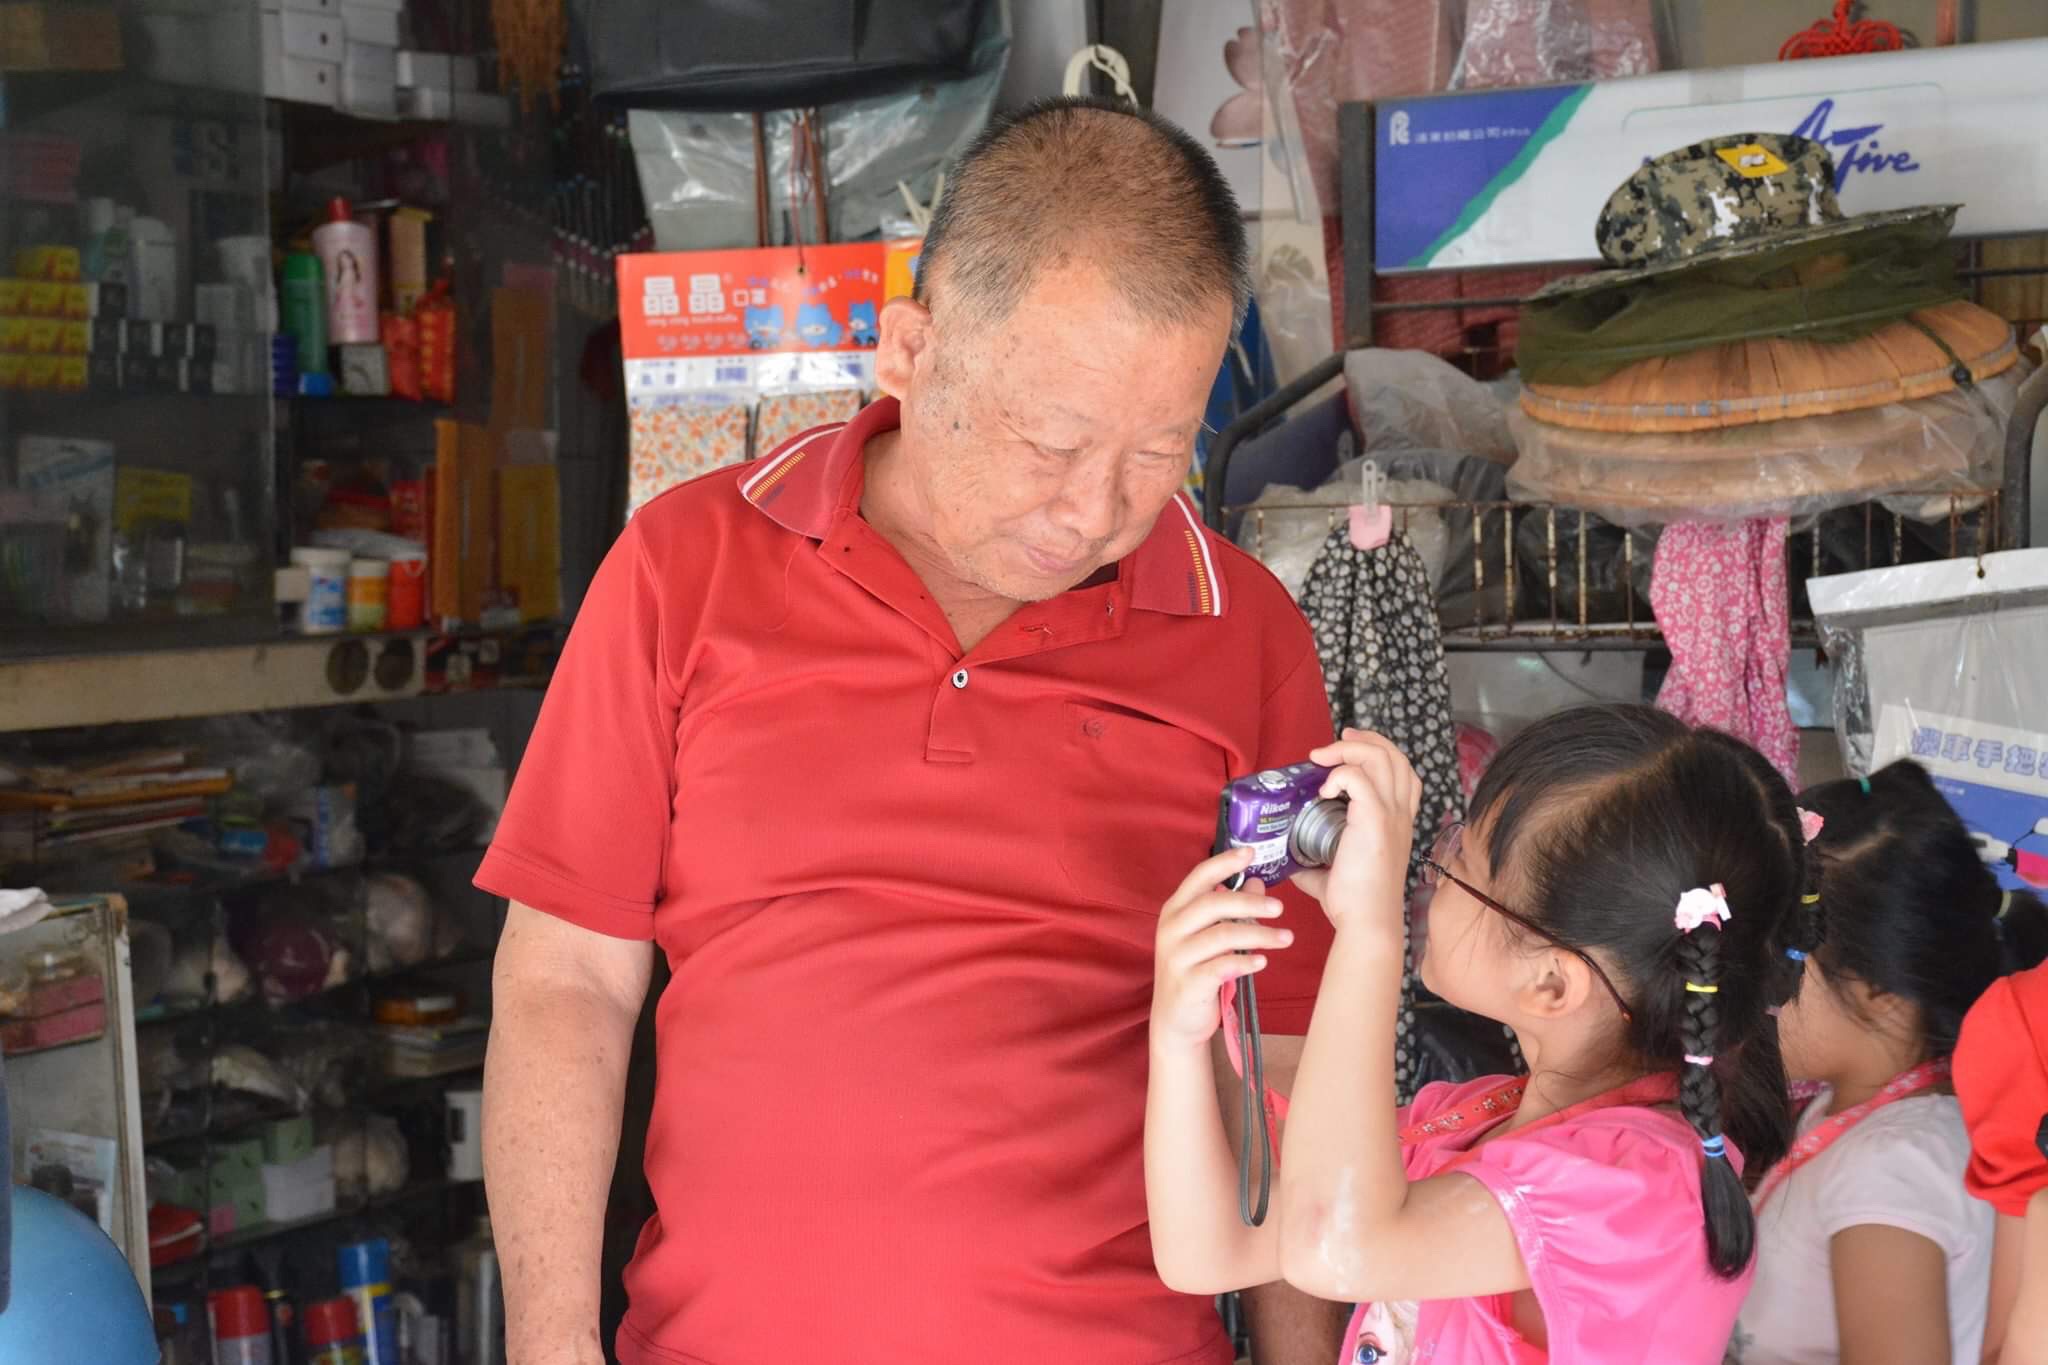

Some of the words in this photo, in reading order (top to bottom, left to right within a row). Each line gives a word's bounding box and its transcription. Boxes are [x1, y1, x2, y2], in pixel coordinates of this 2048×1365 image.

[1911, 725, 2048, 779] 機車手把
[1261, 801, 1291, 814] Nikon
